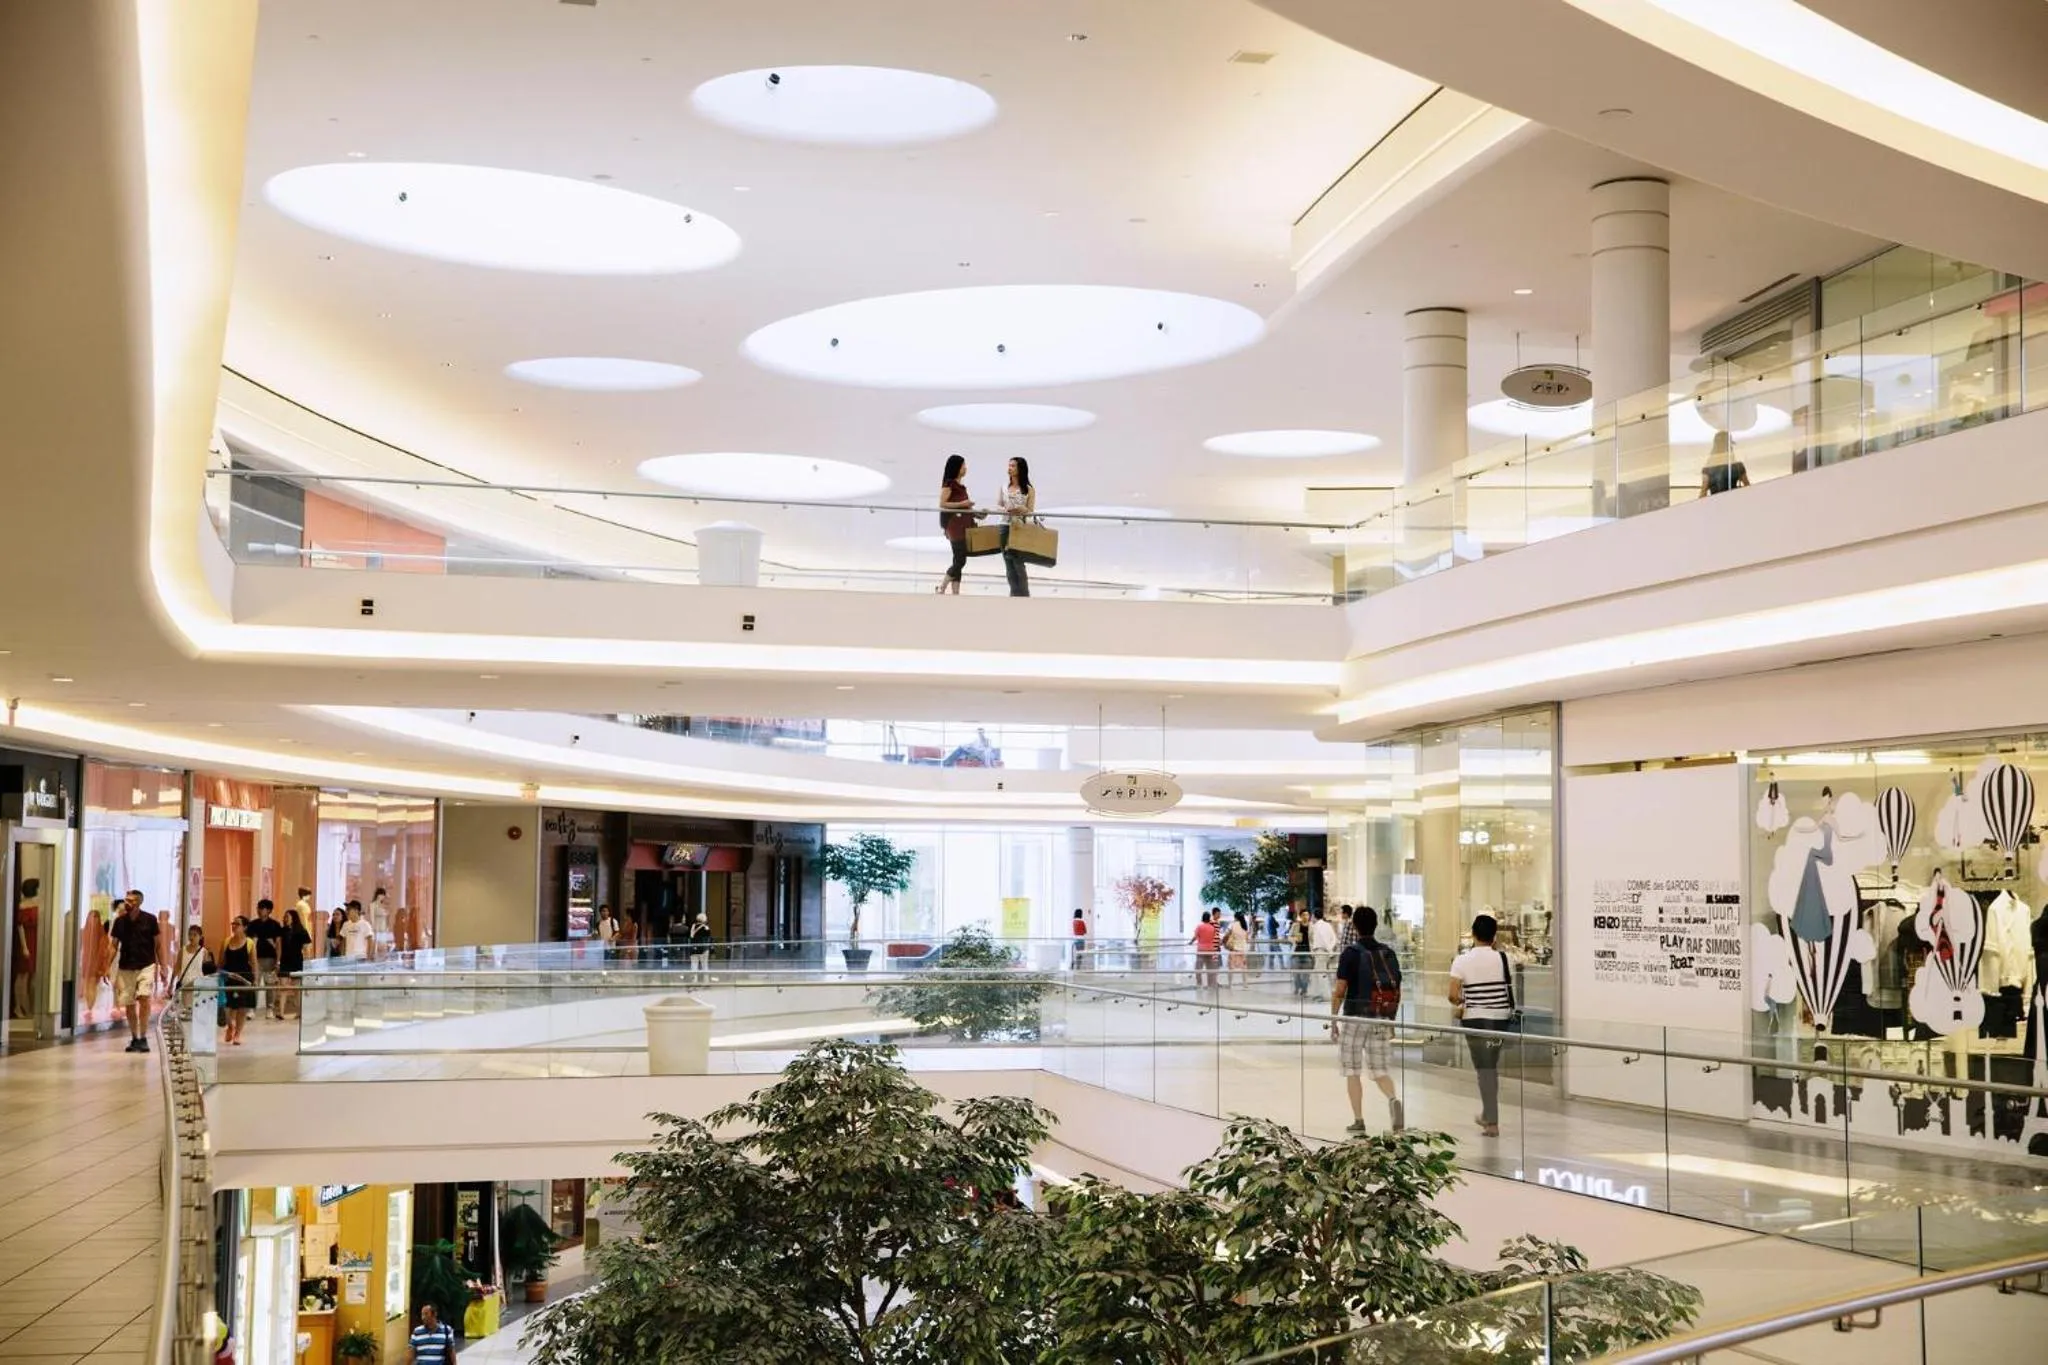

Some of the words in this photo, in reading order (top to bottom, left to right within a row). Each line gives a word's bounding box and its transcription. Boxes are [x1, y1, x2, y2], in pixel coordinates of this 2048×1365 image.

[1627, 880, 1651, 890] COMME
[1653, 881, 1664, 890] des
[1593, 916, 1620, 929] KENZO
[1660, 935, 1685, 949] PLAY
[1686, 938, 1703, 953] RAF
[1705, 939, 1741, 955] SIMONS
[1595, 960, 1640, 972] UNDERCOVER
